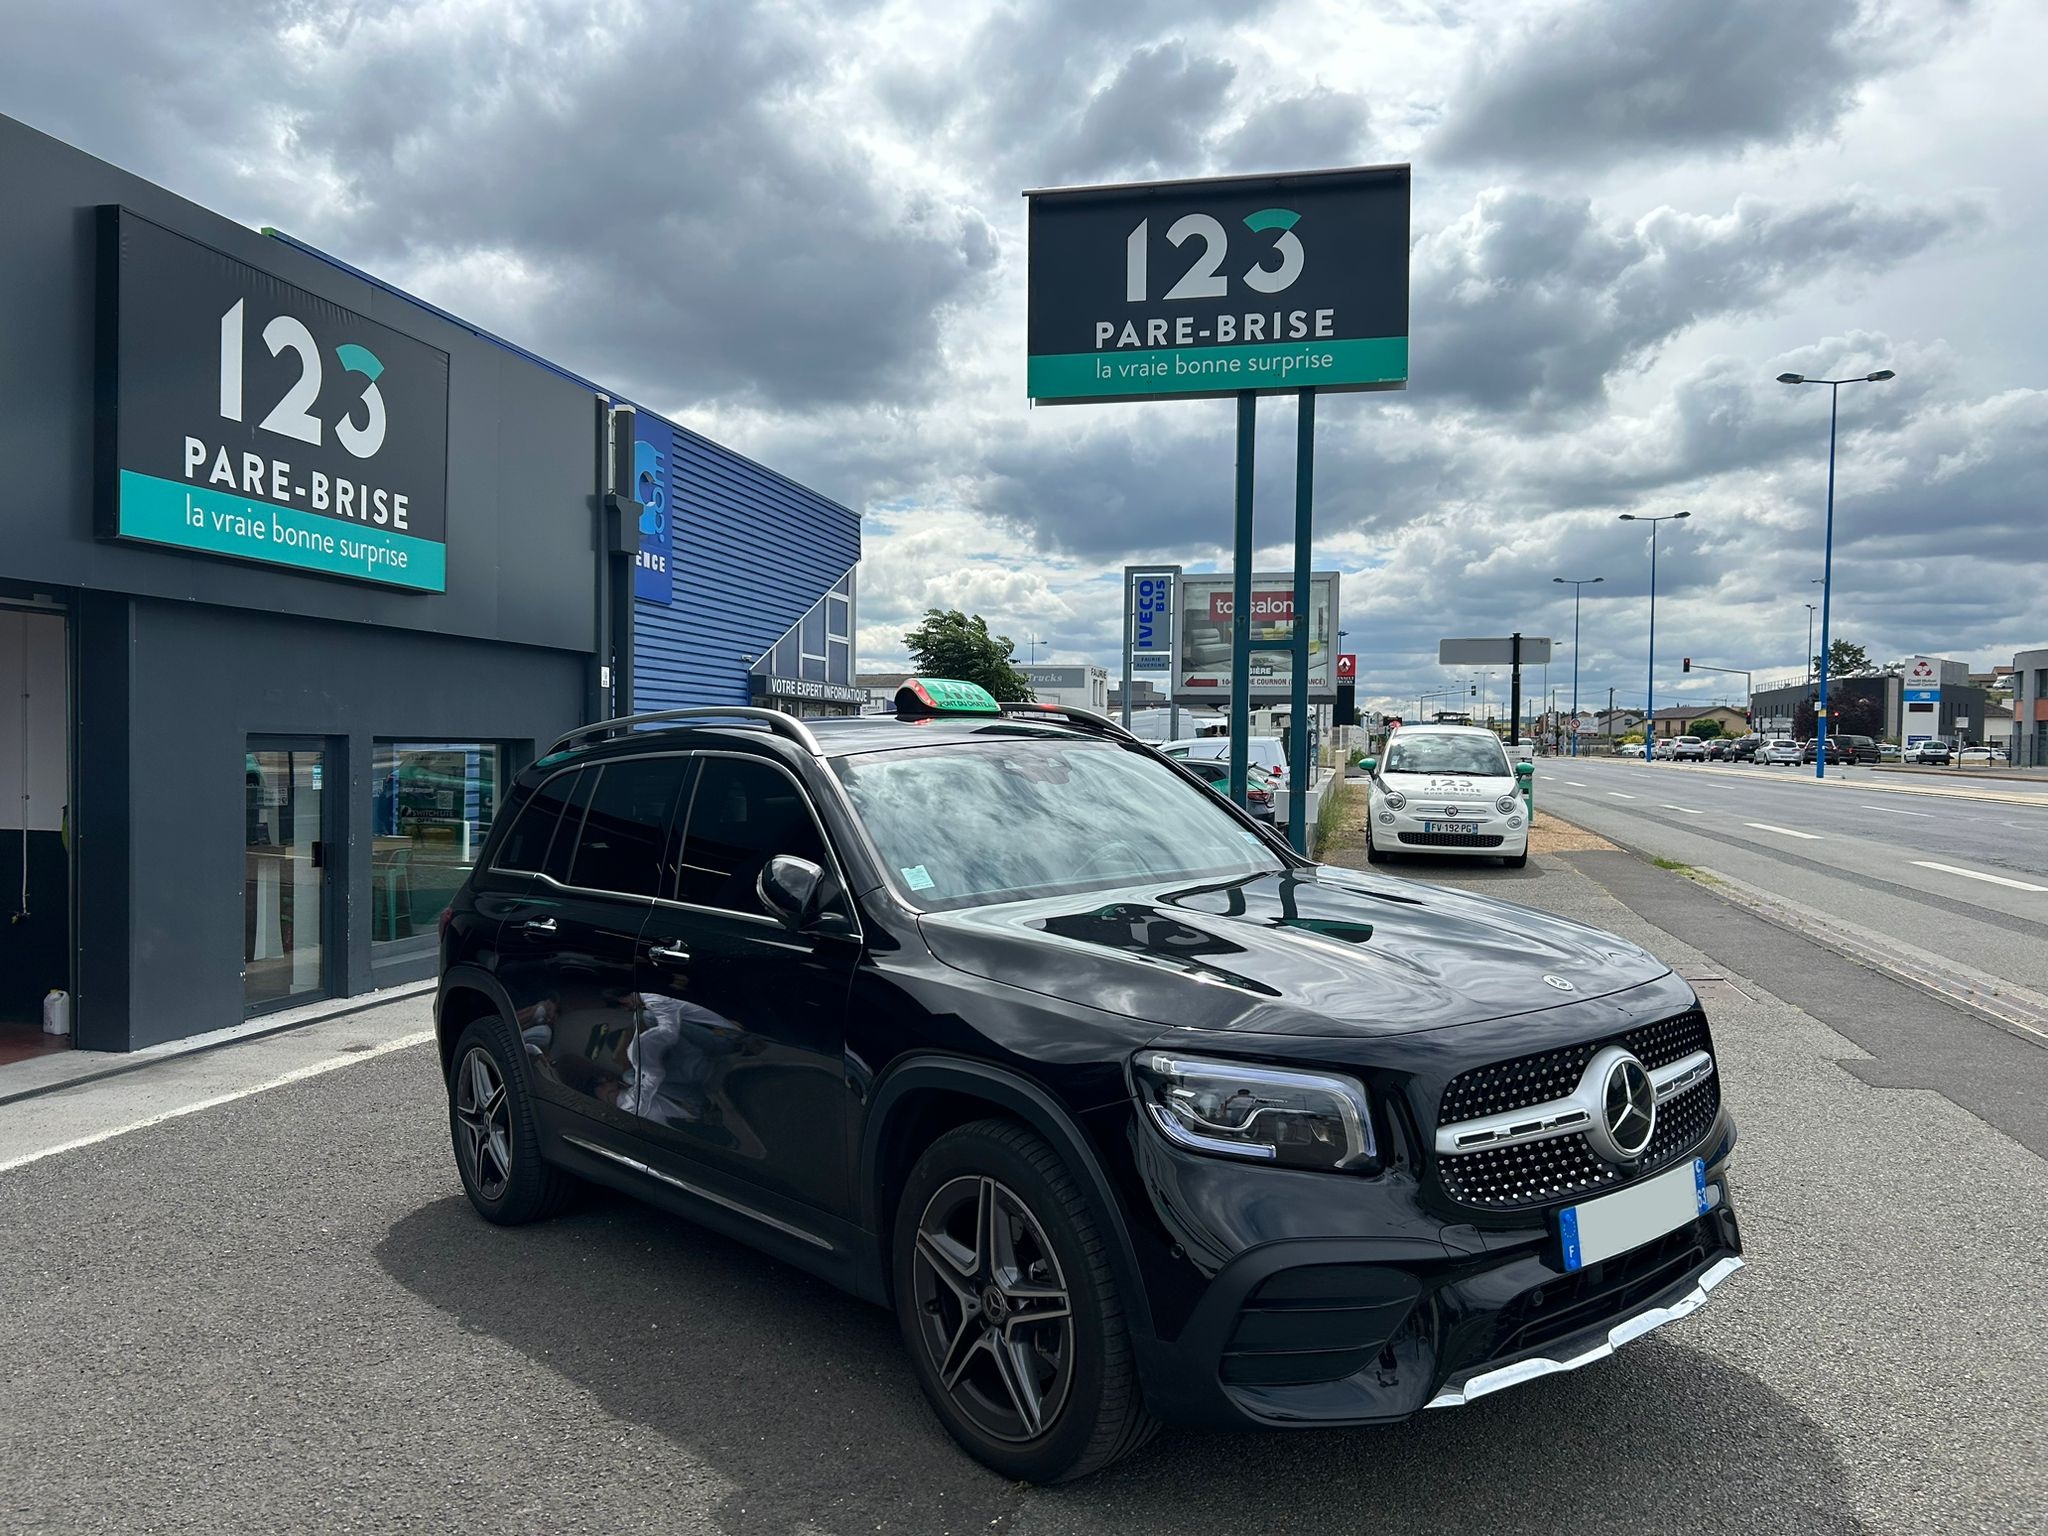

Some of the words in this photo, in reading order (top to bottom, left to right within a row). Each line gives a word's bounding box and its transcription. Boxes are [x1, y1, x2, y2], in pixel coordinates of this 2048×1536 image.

[1126, 208, 1305, 302] 123
[1095, 308, 1334, 349] PARE-BRISE
[220, 297, 387, 459] 123
[1096, 357, 1112, 379] la
[1119, 355, 1168, 377] vraie
[1176, 354, 1241, 375] bonne
[1248, 347, 1334, 378] surprise
[185, 435, 409, 530] PARE-BRISE
[186, 493, 204, 528] la
[211, 507, 265, 540] vraie
[273, 512, 334, 554] bonne
[339, 539, 408, 572] surprise
[1156, 580, 1165, 612] BUS
[1216, 597, 1294, 613] tosalon
[1139, 580, 1153, 647] IVECO
[771, 679, 796, 694] VOTRE
[797, 682, 823, 697] EXPERT
[824, 685, 868, 702] INFORMATIQUE
[933, 682, 979, 694] TAXI
[1028, 673, 1062, 682] Trucks
[1430, 779, 1473, 787] 123
[1568, 1245, 1575, 1258] F
